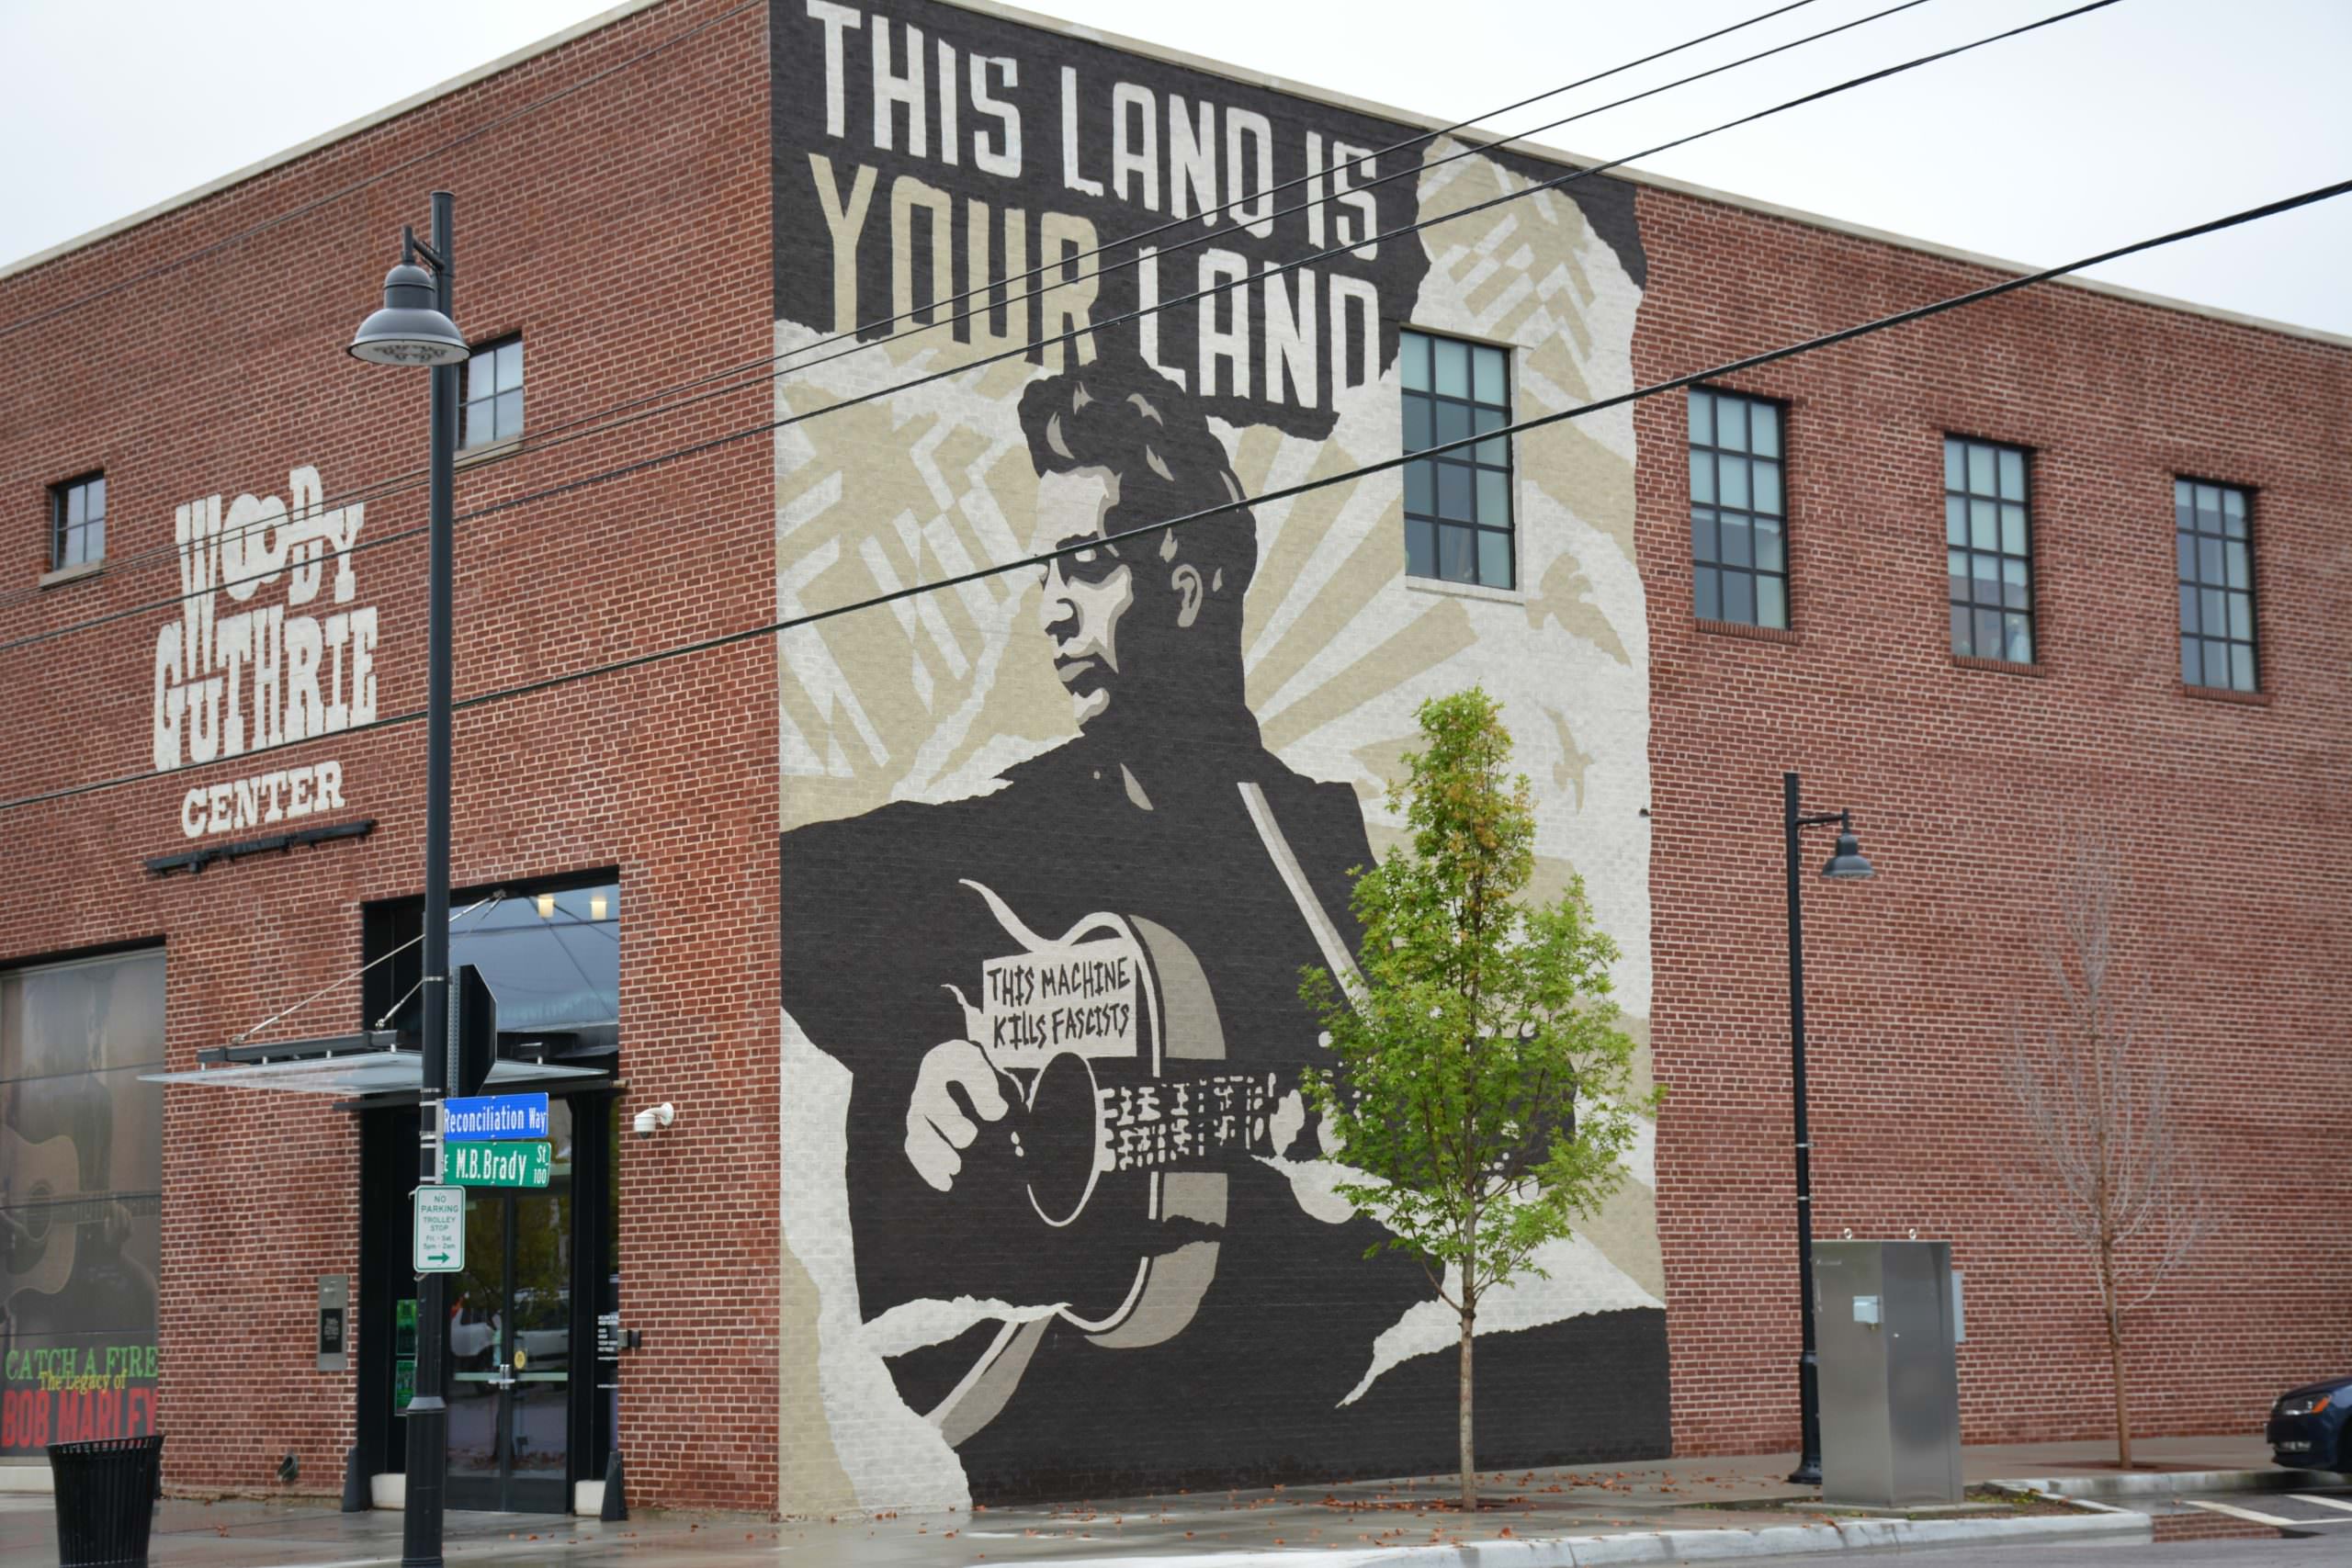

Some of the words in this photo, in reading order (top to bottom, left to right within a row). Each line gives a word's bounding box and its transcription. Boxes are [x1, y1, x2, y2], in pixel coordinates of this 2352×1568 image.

[807, 0, 1022, 178] THIS
[1061, 65, 1273, 238] LAND
[1306, 130, 1376, 261] IS
[808, 152, 1100, 372] YOUR
[1138, 245, 1378, 412] LAND
[175, 465, 365, 679] WOODY
[153, 604, 378, 772] GUTHRIE
[181, 761, 345, 839] CENTER
[987, 964, 1035, 1006] THIS
[1041, 956, 1131, 998] MACHINE
[993, 1011, 1047, 1050] KILLS
[1052, 1002, 1130, 1044] FASCISTS
[444, 1106, 525, 1133] Reconciliation
[528, 1107, 547, 1134] Way
[534, 1168, 547, 1184] 100
[537, 1145, 547, 1164] St
[421, 1204, 458, 1213] PARKING
[434, 1195, 447, 1203] NO
[6, 1348, 77, 1380] CATCH
[84, 1348, 96, 1378] A
[106, 1346, 159, 1378] FIRE
[40, 1370, 61, 1391] The
[65, 1371, 110, 1395] Legacy
[113, 1369, 128, 1390] of
[2, 1390, 51, 1448] BOB
